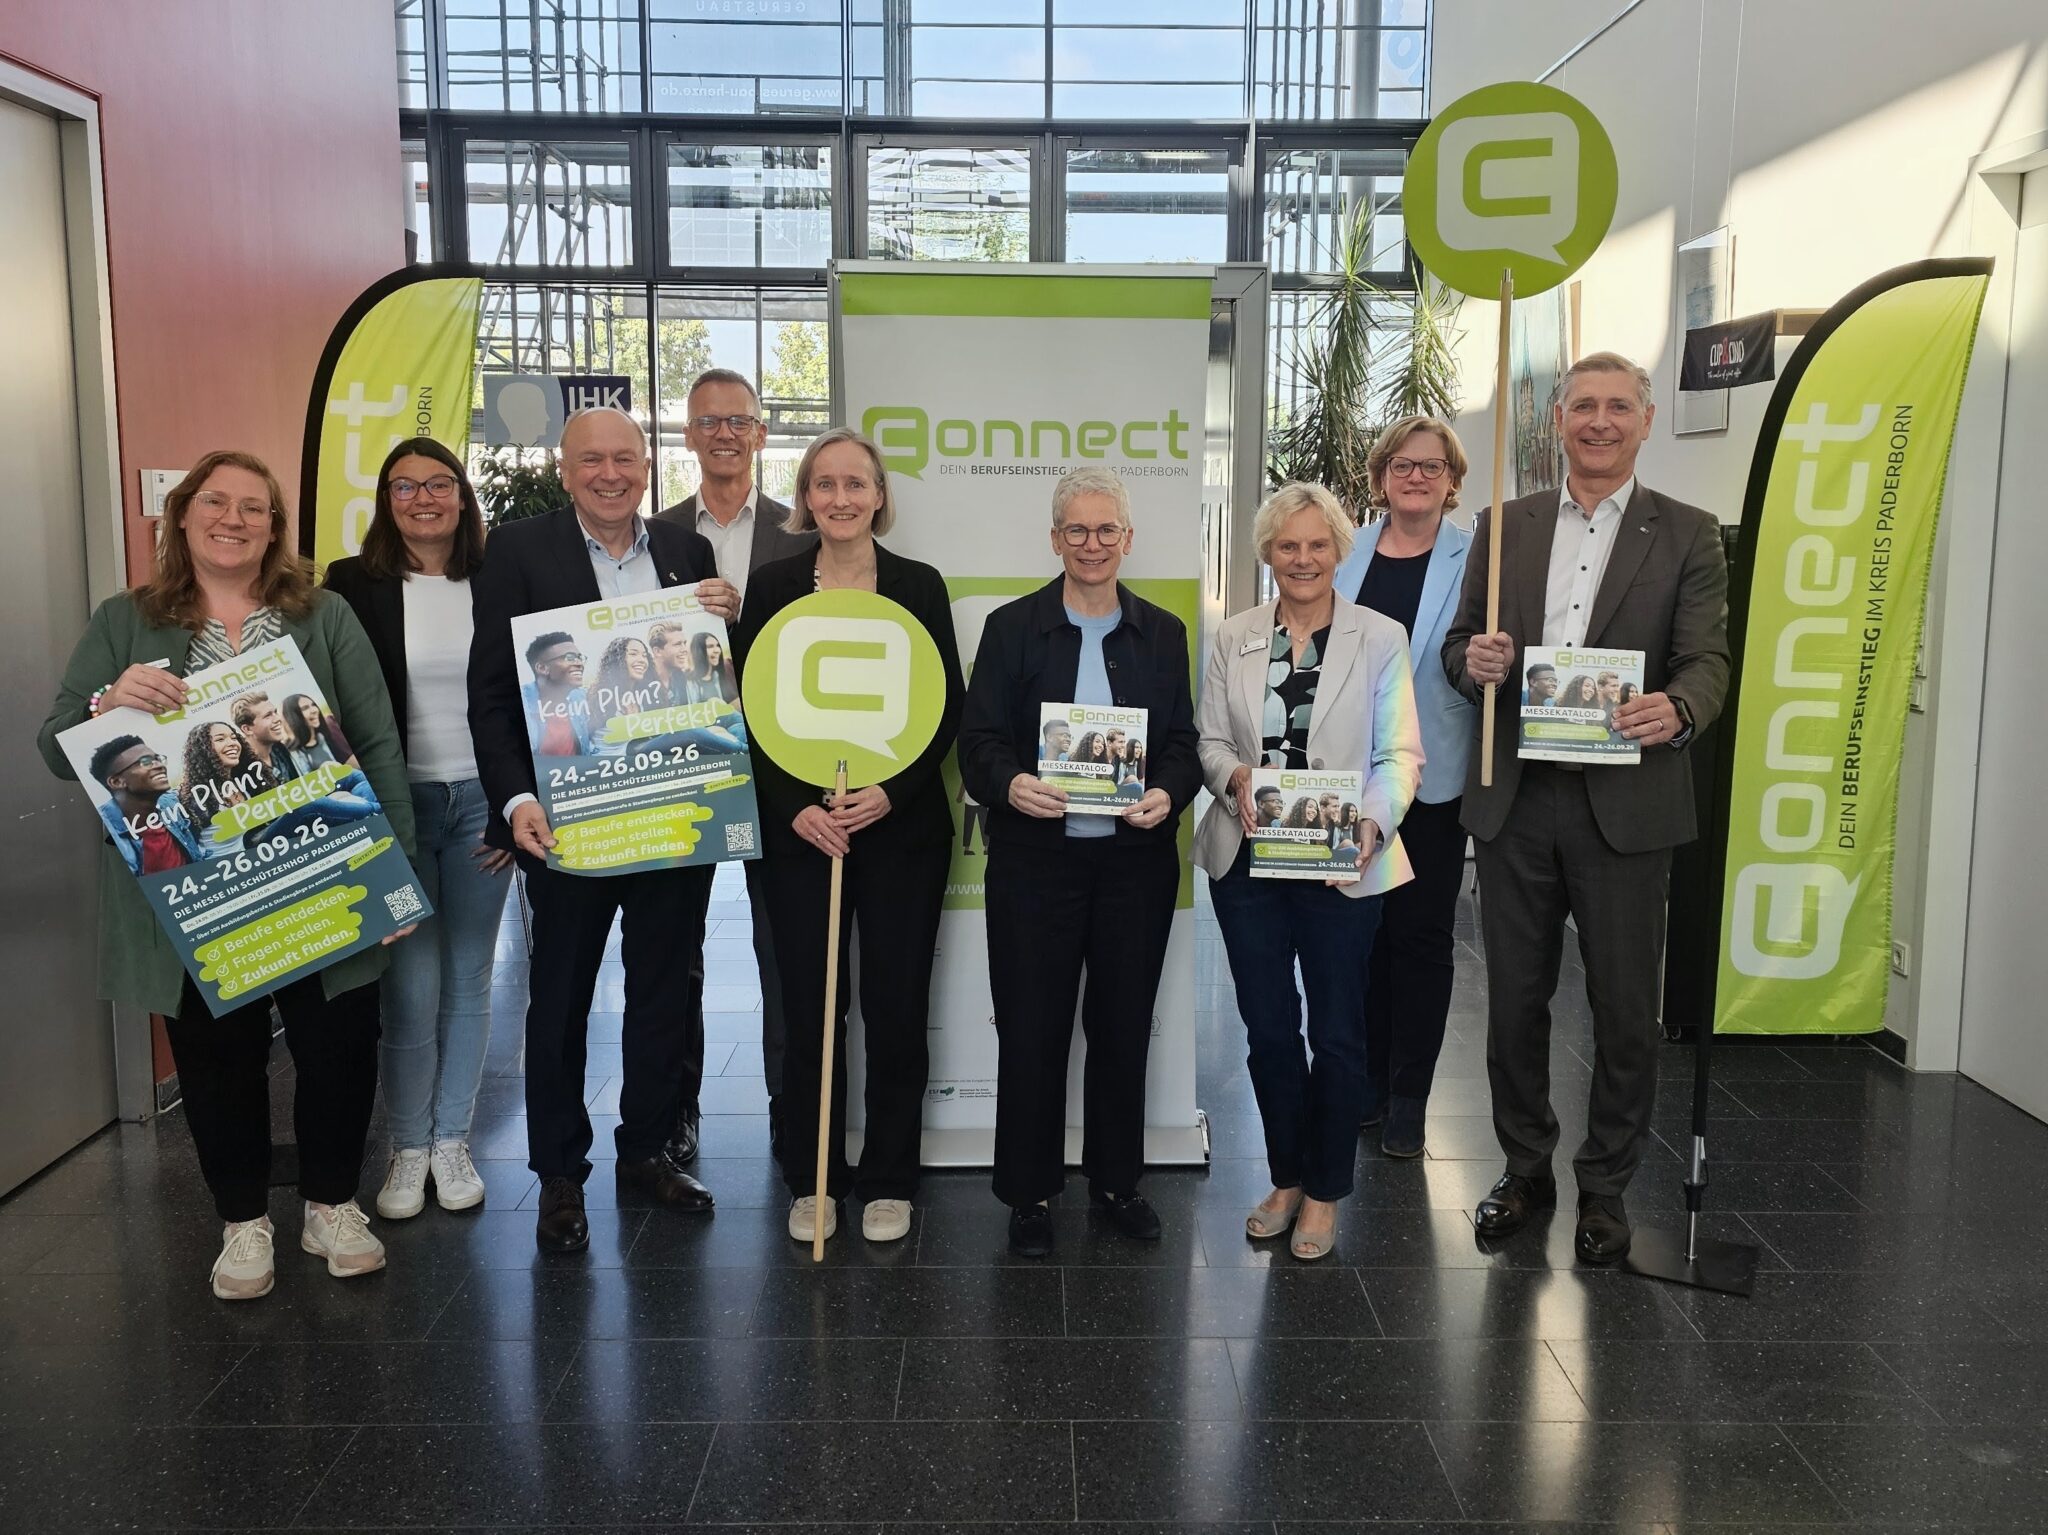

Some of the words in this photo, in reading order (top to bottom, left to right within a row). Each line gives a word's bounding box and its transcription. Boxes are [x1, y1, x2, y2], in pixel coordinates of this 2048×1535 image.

[568, 386, 626, 413] IHK
[862, 406, 1189, 481] Connect
[940, 464, 967, 475] DEIN
[971, 465, 1067, 476] BERUFSEINSTIEG
[1120, 466, 1189, 477] PADERBORN
[1876, 405, 1913, 531] PADERBORN
[1868, 536, 1892, 593] KREIS
[587, 594, 699, 631] Connec
[1865, 598, 1885, 621] IM
[1555, 651, 1637, 668] Connect
[537, 696, 591, 723] Kein
[598, 680, 662, 713] Plan?
[1730, 402, 1881, 979] Connect
[625, 702, 721, 737] Perfekt!
[1070, 708, 1142, 724] Connect
[1525, 708, 1598, 719] MESSEKATALOG
[1842, 627, 1881, 796] BERUFSEINSTIEG
[551, 791, 567, 800] DIE
[568, 785, 598, 797] MESSE
[599, 783, 610, 791] IM
[612, 769, 676, 788] SCHÜTZENHOF
[677, 760, 731, 775] PADERBORN
[1041, 761, 1107, 772] MESSEKATALOG
[1280, 774, 1357, 790] Connect
[122, 803, 189, 841] Kein
[191, 761, 266, 812] Plan?
[231, 764, 342, 829] Perfekt!
[580, 819, 624, 838] Berufe
[626, 806, 698, 828] entdecken.
[581, 835, 627, 852] Fragen
[629, 826, 677, 842] stellen.
[1254, 829, 1321, 838] MESSEKATALOG
[1838, 802, 1857, 849] DEIN
[173, 905, 193, 920] DIE
[193, 891, 226, 911] MESSE
[226, 884, 240, 896] IM
[240, 853, 310, 890] SCHÜTZENHOF
[311, 825, 368, 857] PADERBORN
[582, 847, 639, 866] Zukunft
[640, 841, 689, 856] finden.
[224, 925, 273, 953] Berufe
[275, 891, 351, 929] entdecken.
[232, 940, 282, 969] Fragen
[285, 917, 336, 946] stellen.
[241, 952, 301, 985] Zukunft
[301, 929, 354, 957] finden.
